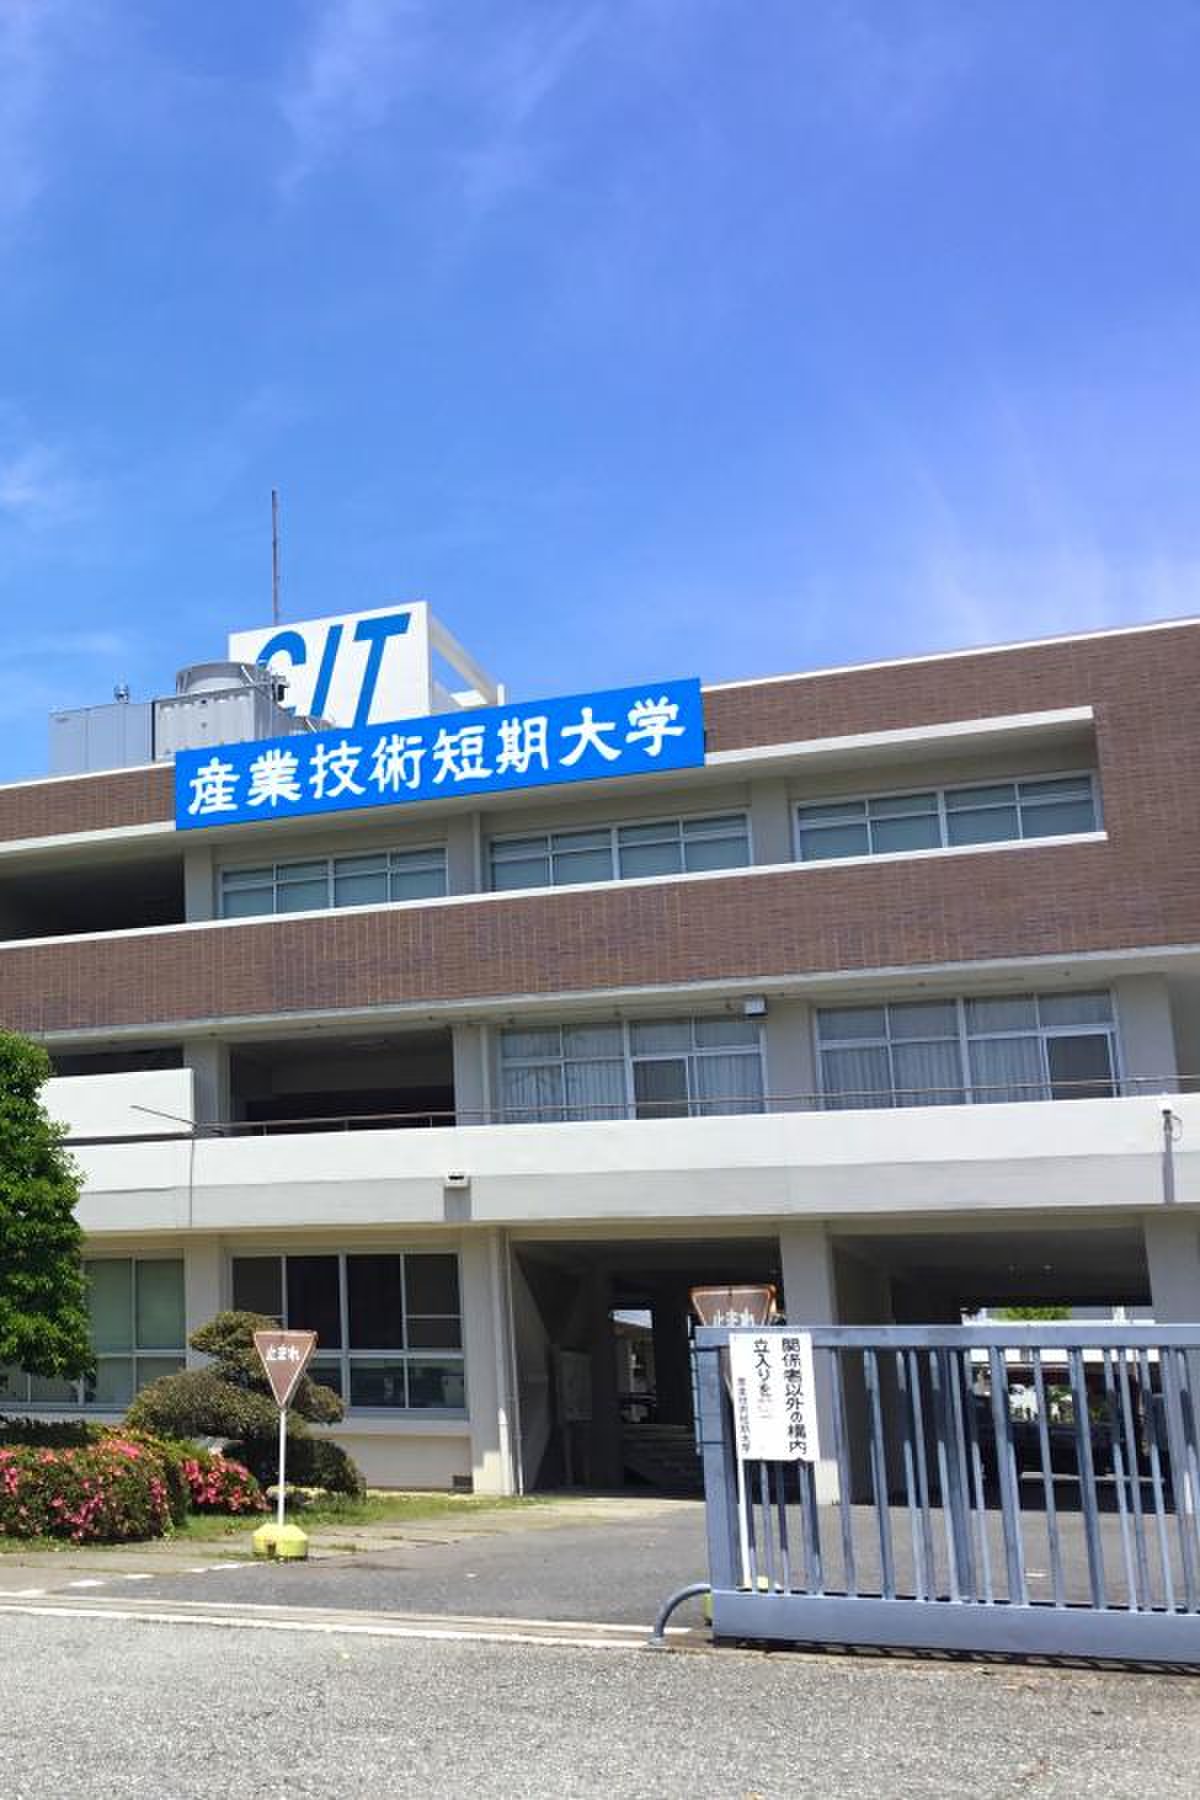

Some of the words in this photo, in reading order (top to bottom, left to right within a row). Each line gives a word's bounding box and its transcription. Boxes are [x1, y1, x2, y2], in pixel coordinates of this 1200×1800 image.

[187, 696, 687, 817] 産業技術短期大学
[265, 1344, 300, 1361] 止まれ
[781, 1337, 808, 1455] 関係者以外の構内
